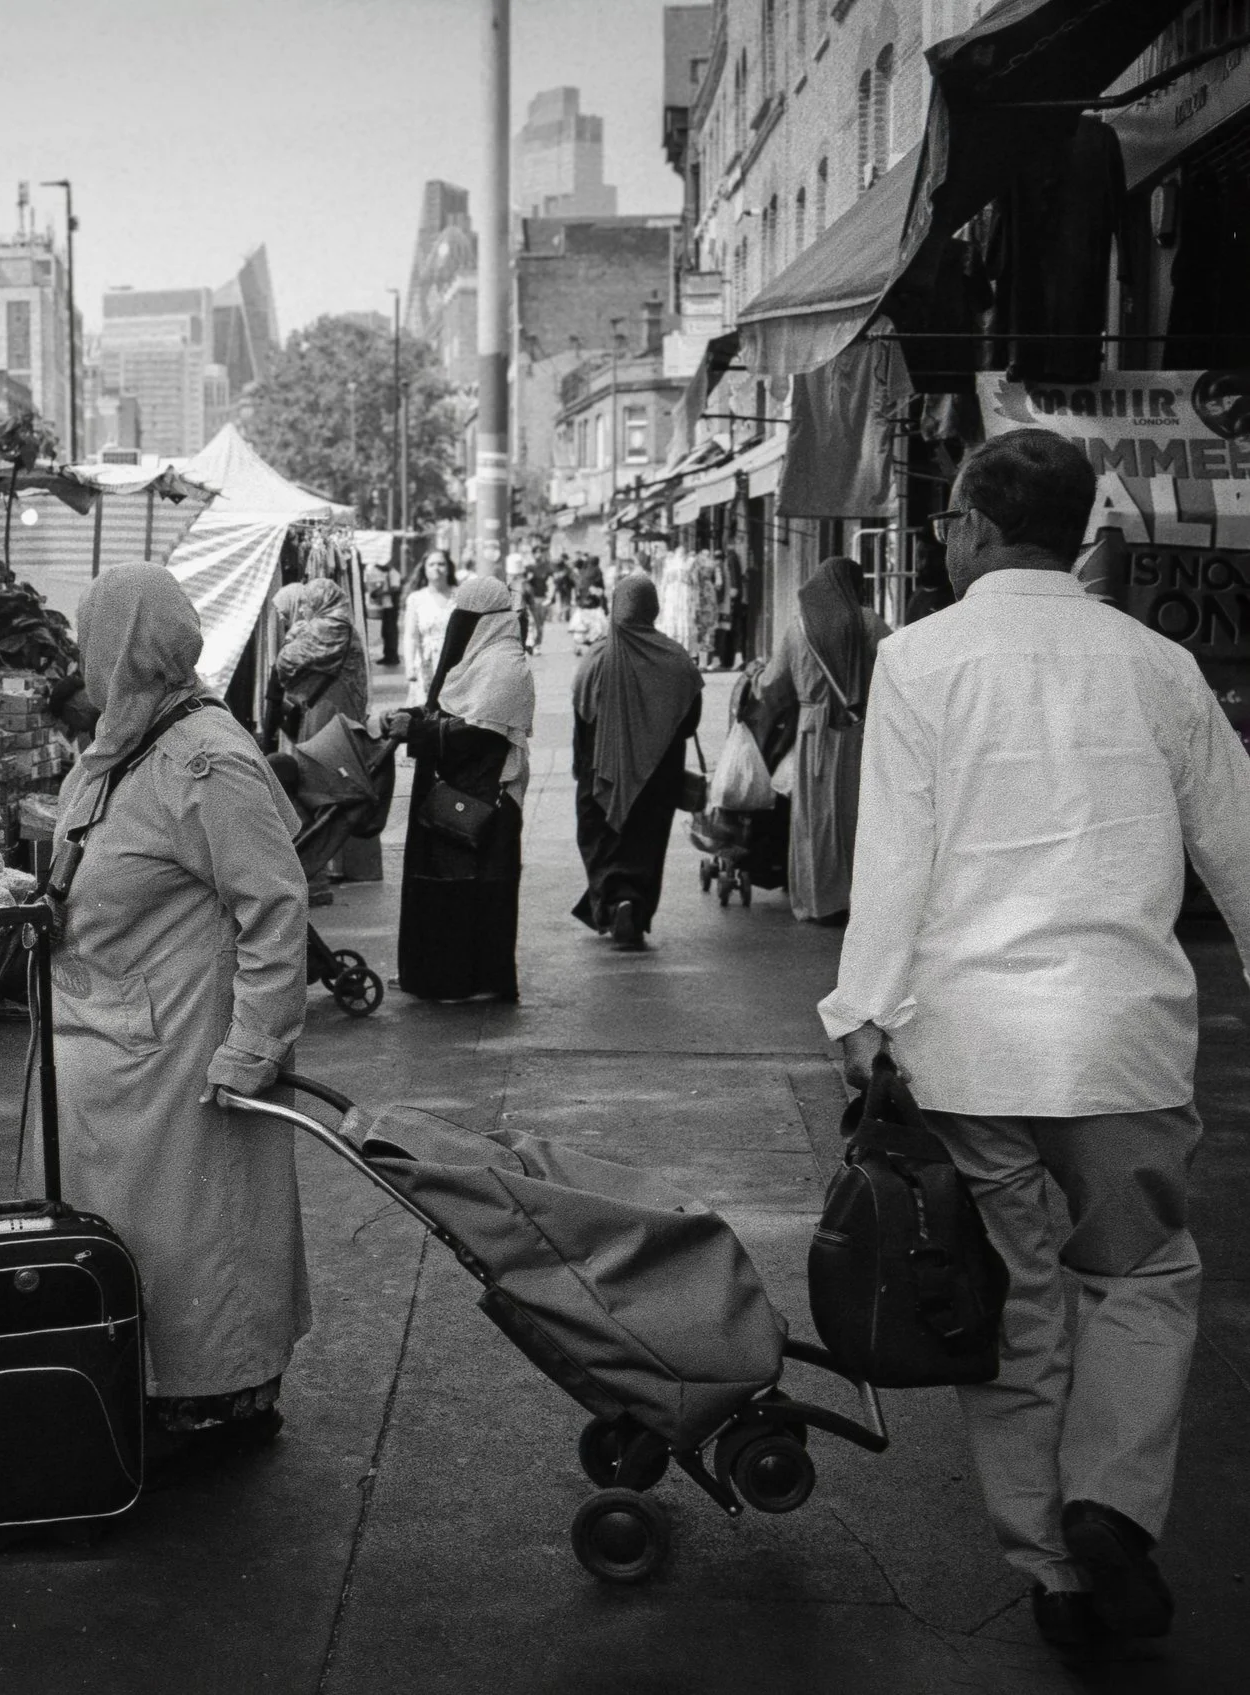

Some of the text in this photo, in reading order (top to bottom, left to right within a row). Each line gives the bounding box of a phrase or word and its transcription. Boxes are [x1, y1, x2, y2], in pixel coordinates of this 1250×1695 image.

[1032, 389, 1176, 417] MAHIR
[1133, 418, 1179, 426] LONDON
[1125, 552, 1162, 588] IS
